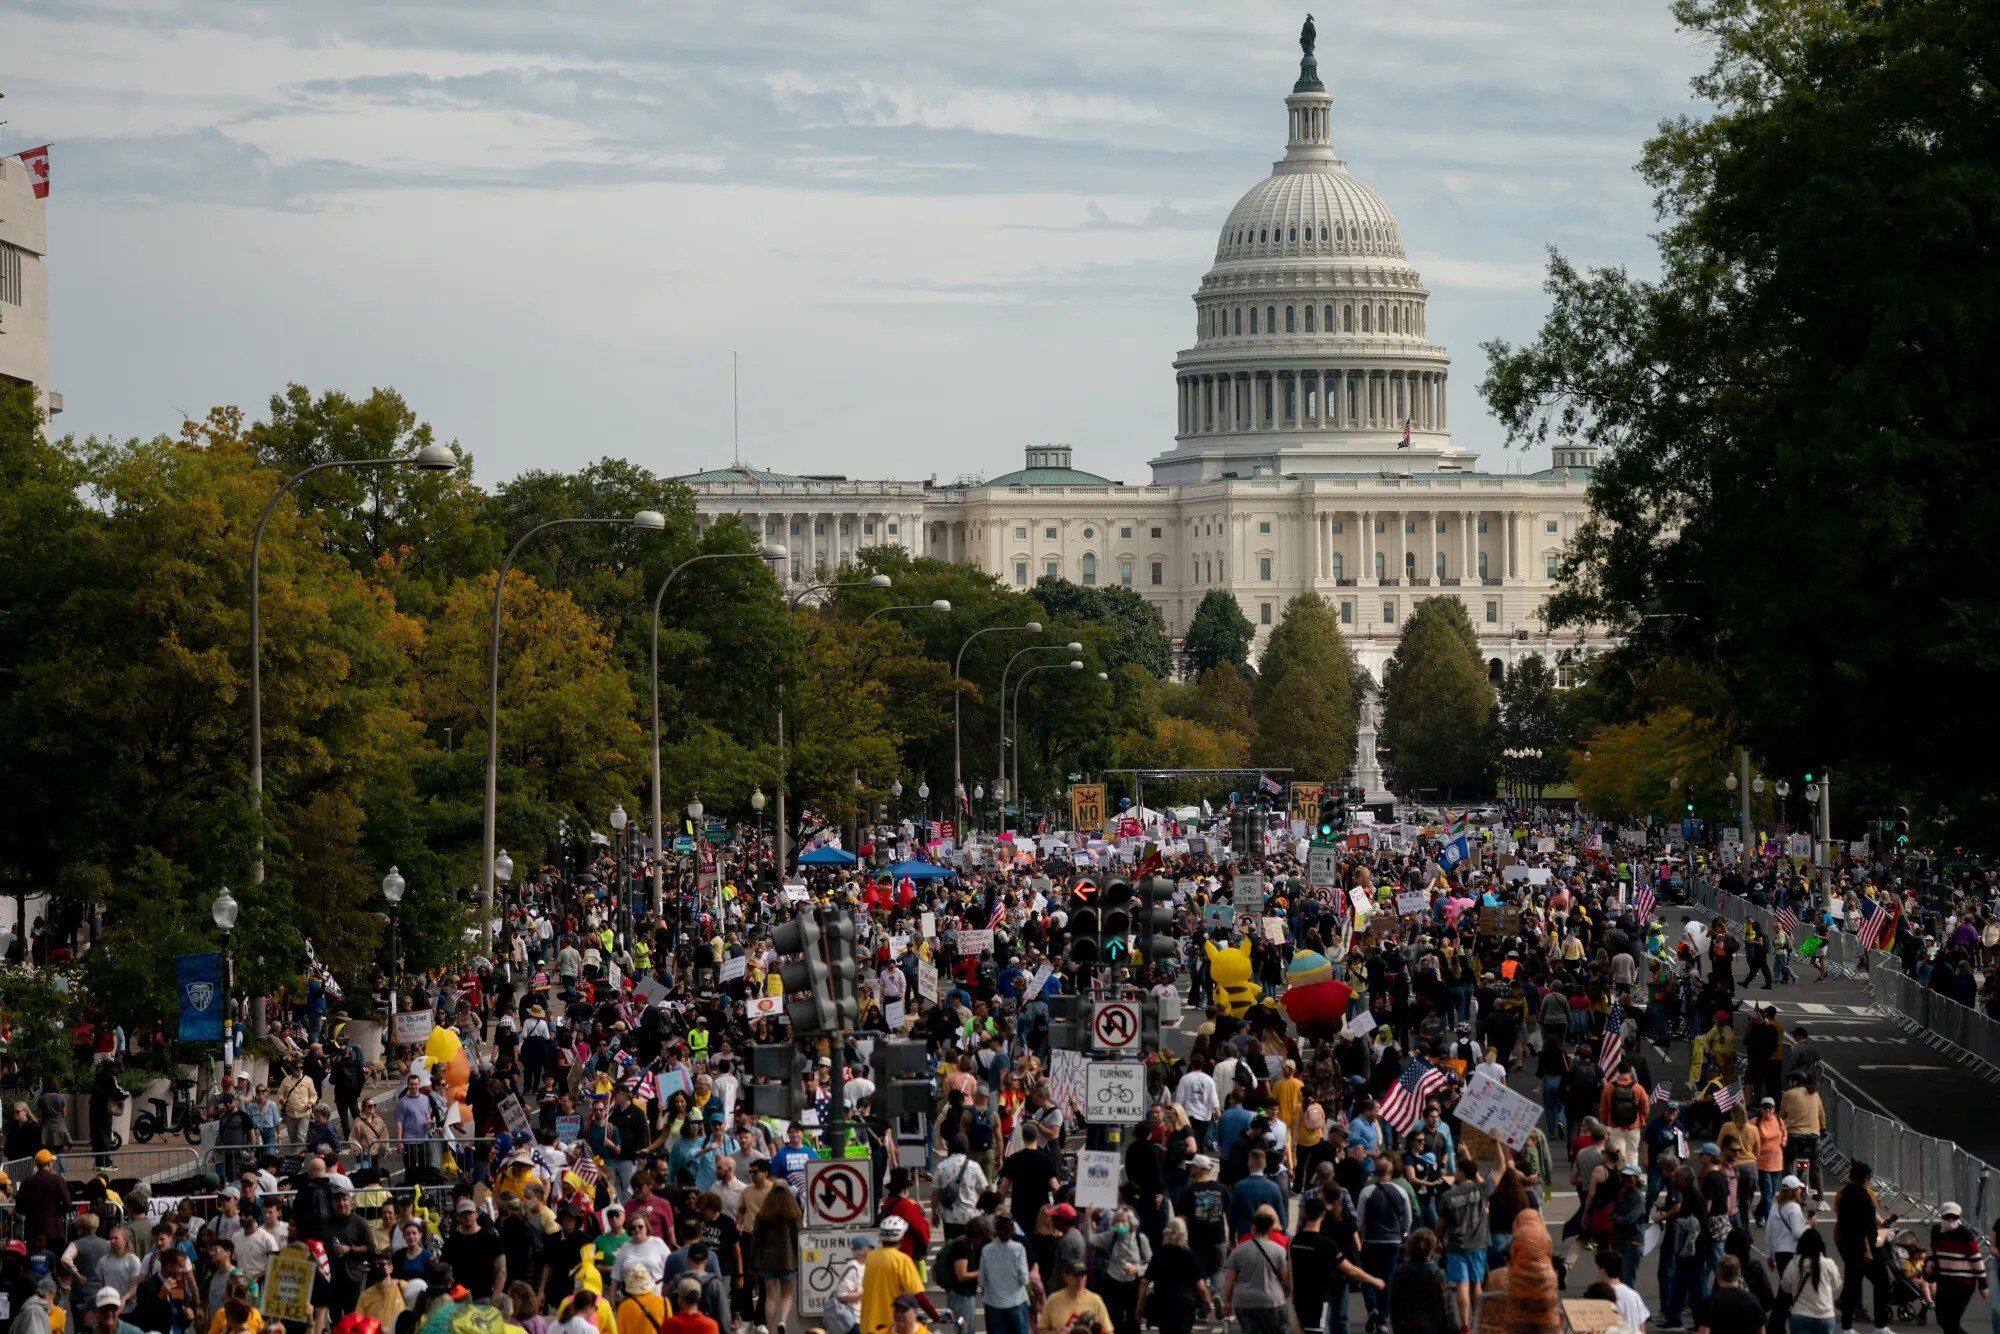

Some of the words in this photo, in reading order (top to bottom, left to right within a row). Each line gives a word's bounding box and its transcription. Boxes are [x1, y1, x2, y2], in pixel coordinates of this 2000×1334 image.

[1079, 805, 1099, 821] NO
[1297, 803, 1317, 819] NO
[1809, 1035, 1908, 1045] ONLY
[1052, 1067, 1087, 1085] KINGS
[1099, 1069, 1133, 1079] TURNING
[1088, 1106, 1104, 1116] USE
[1107, 1106, 1142, 1116] X-WALKS
[815, 1237, 852, 1249] TURNI
